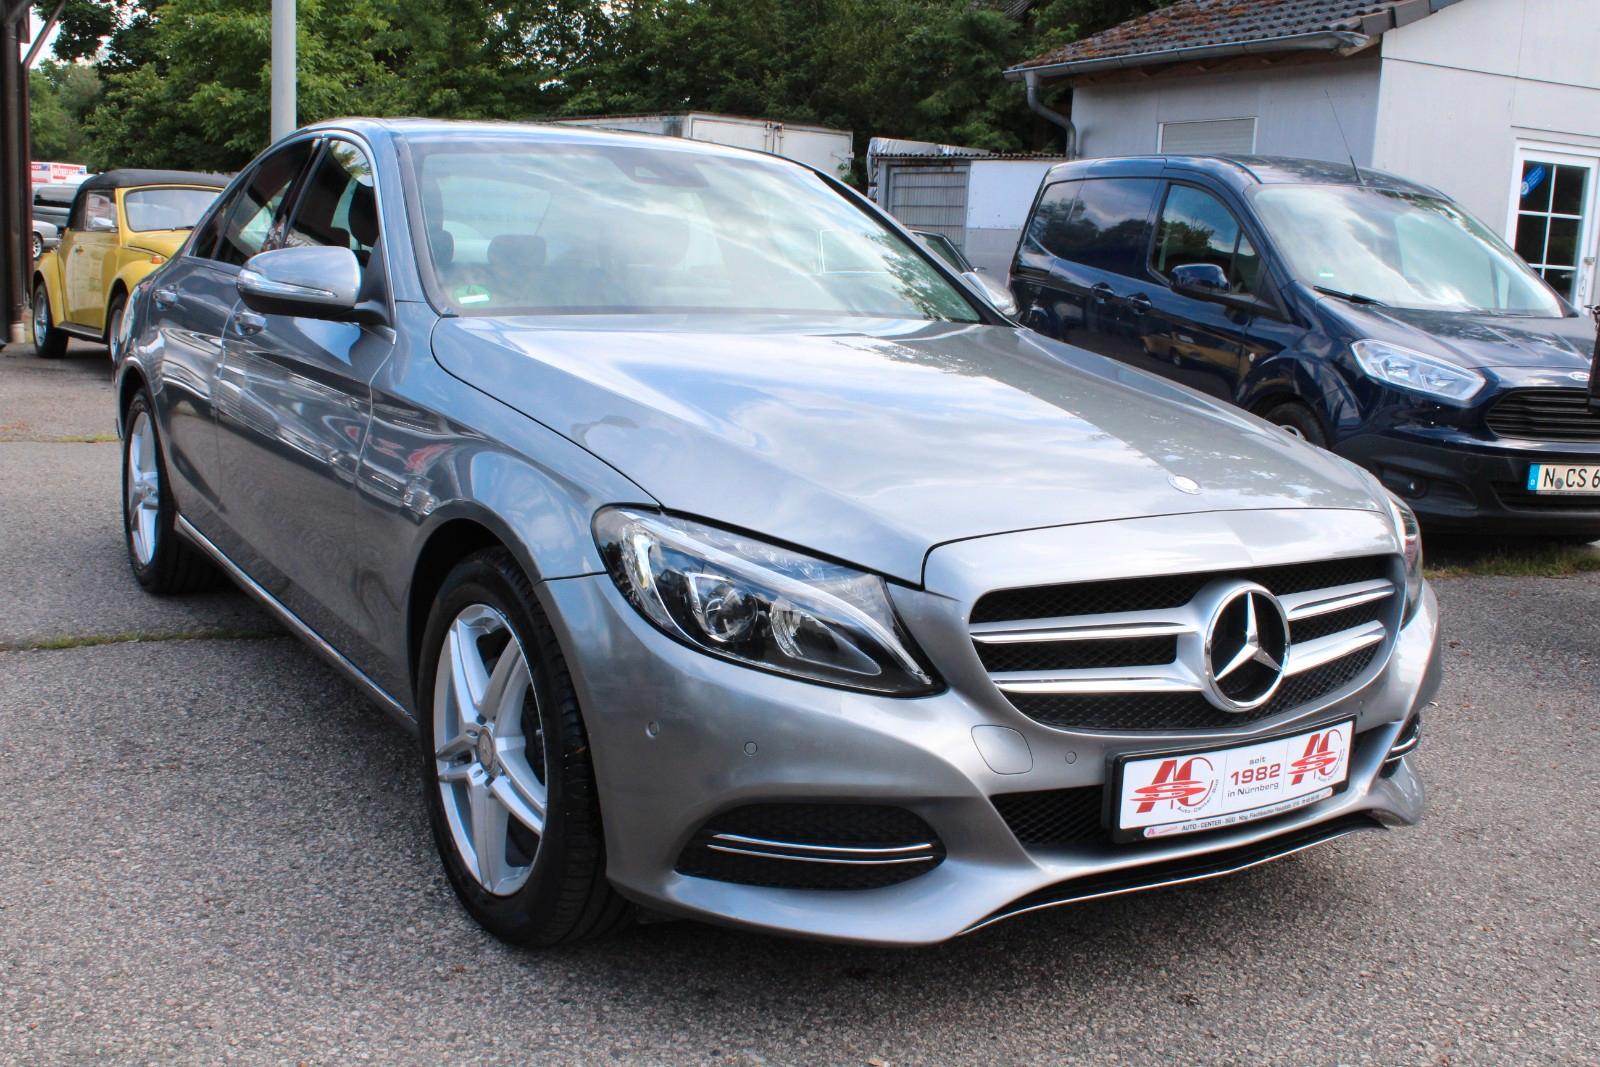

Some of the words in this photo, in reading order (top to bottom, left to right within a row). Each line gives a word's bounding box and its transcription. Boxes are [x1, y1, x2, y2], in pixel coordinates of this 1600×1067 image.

[1543, 467, 1556, 488] N
[1566, 468, 1588, 488] CS
[1249, 756, 1266, 765] seit
[1230, 762, 1281, 786] 1982
[1227, 790, 1236, 798] in
[1237, 781, 1280, 796] Nürnberg
[1182, 823, 1197, 832] AUTO
[1200, 819, 1222, 829] CENTER
